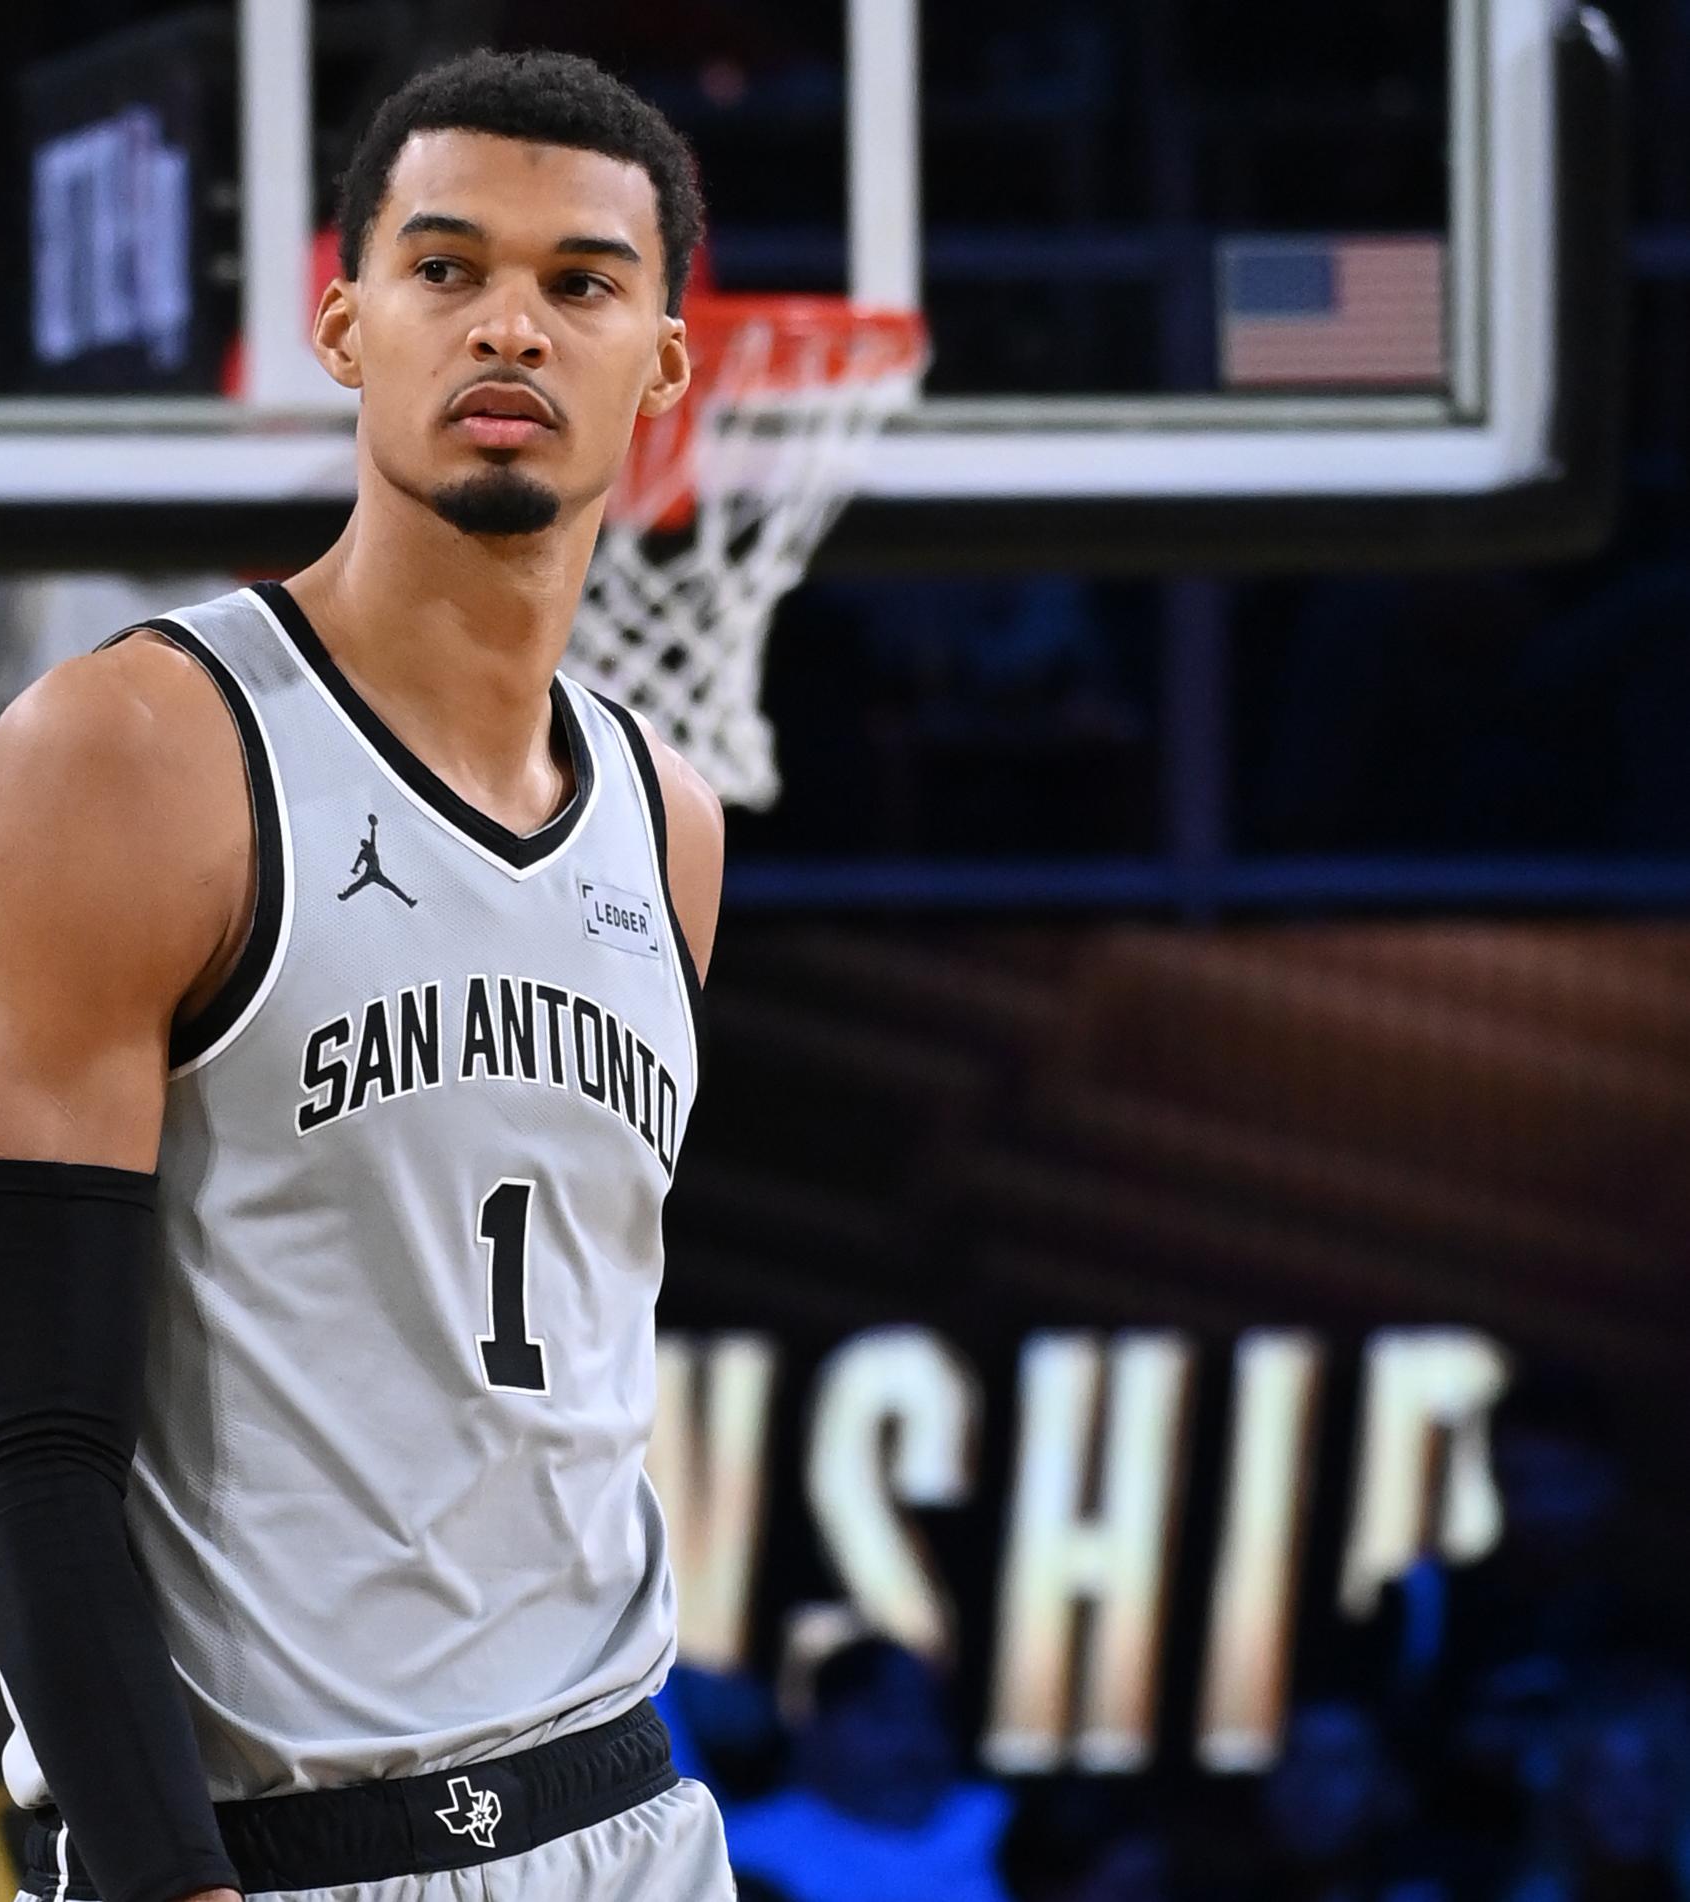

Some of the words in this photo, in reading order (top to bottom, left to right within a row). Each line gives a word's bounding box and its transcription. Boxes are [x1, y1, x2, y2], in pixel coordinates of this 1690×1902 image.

[594, 900, 649, 936] LEDGER
[294, 979, 443, 1137] SAN
[458, 973, 677, 1187] ANTONIO
[475, 1177, 550, 1396] 1
